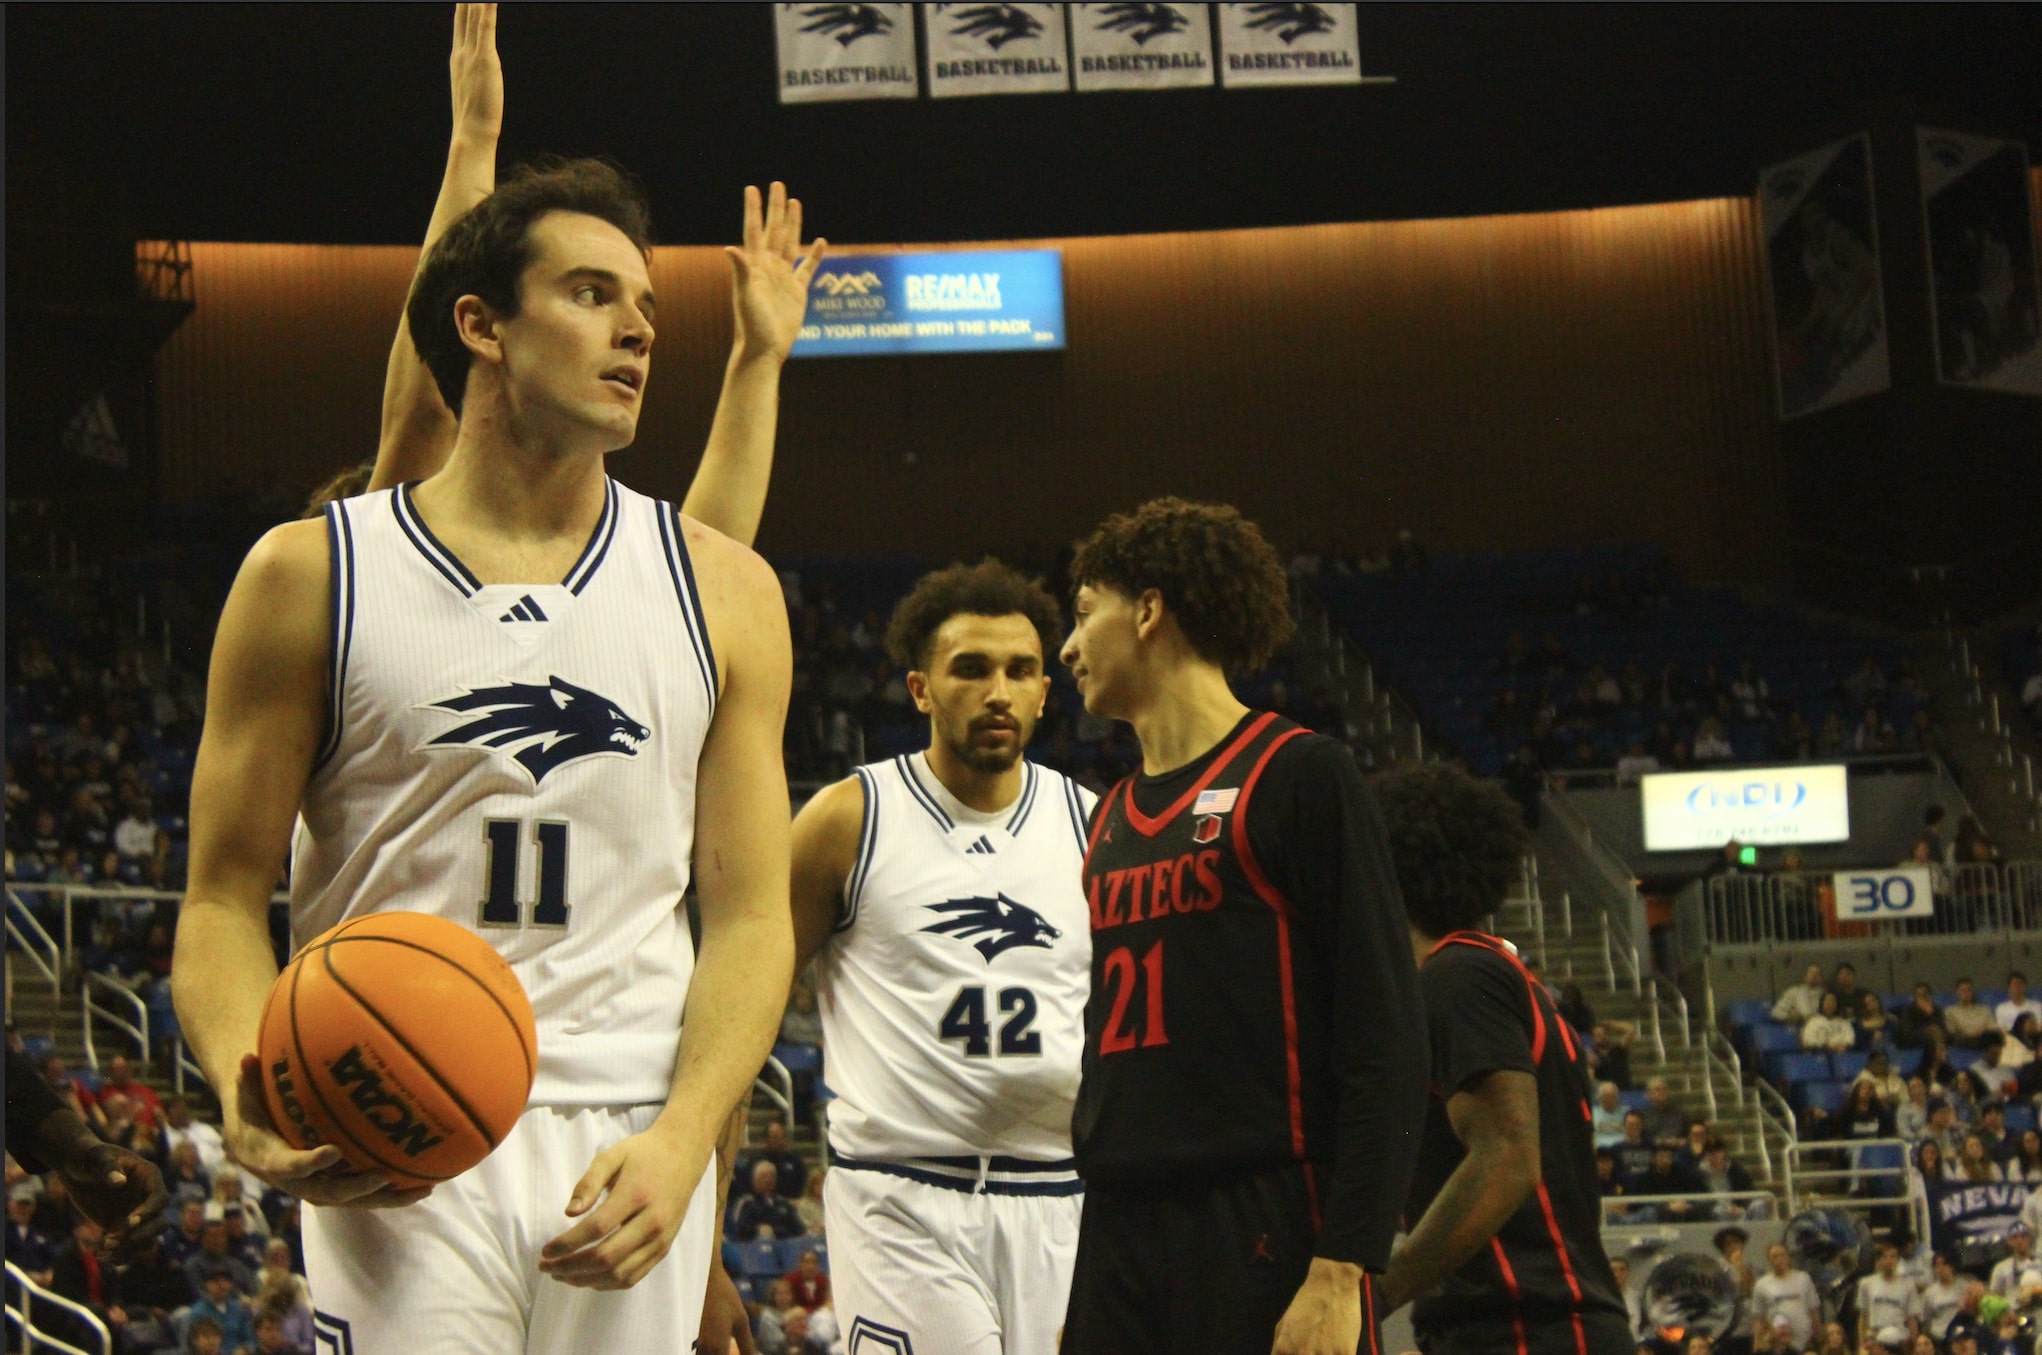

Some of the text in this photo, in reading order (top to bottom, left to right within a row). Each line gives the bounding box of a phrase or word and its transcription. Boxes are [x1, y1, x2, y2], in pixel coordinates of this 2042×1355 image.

[936, 57, 1061, 78] BASKETBALL
[1081, 52, 1206, 72] BASKETBALL
[1229, 50, 1354, 70] BASKETBALL
[785, 66, 912, 86] BASKETBALL
[906, 273, 1001, 299] RE/MAX
[797, 319, 1031, 340] ND YOUR HOME WITH THE PACK
[478, 817, 571, 930] 11
[1088, 849, 1223, 931] AZTECS
[1849, 876, 1915, 913] 30
[1100, 938, 1169, 1057] 21
[938, 985, 1042, 1059] 42
[331, 1045, 443, 1158] NCAA
